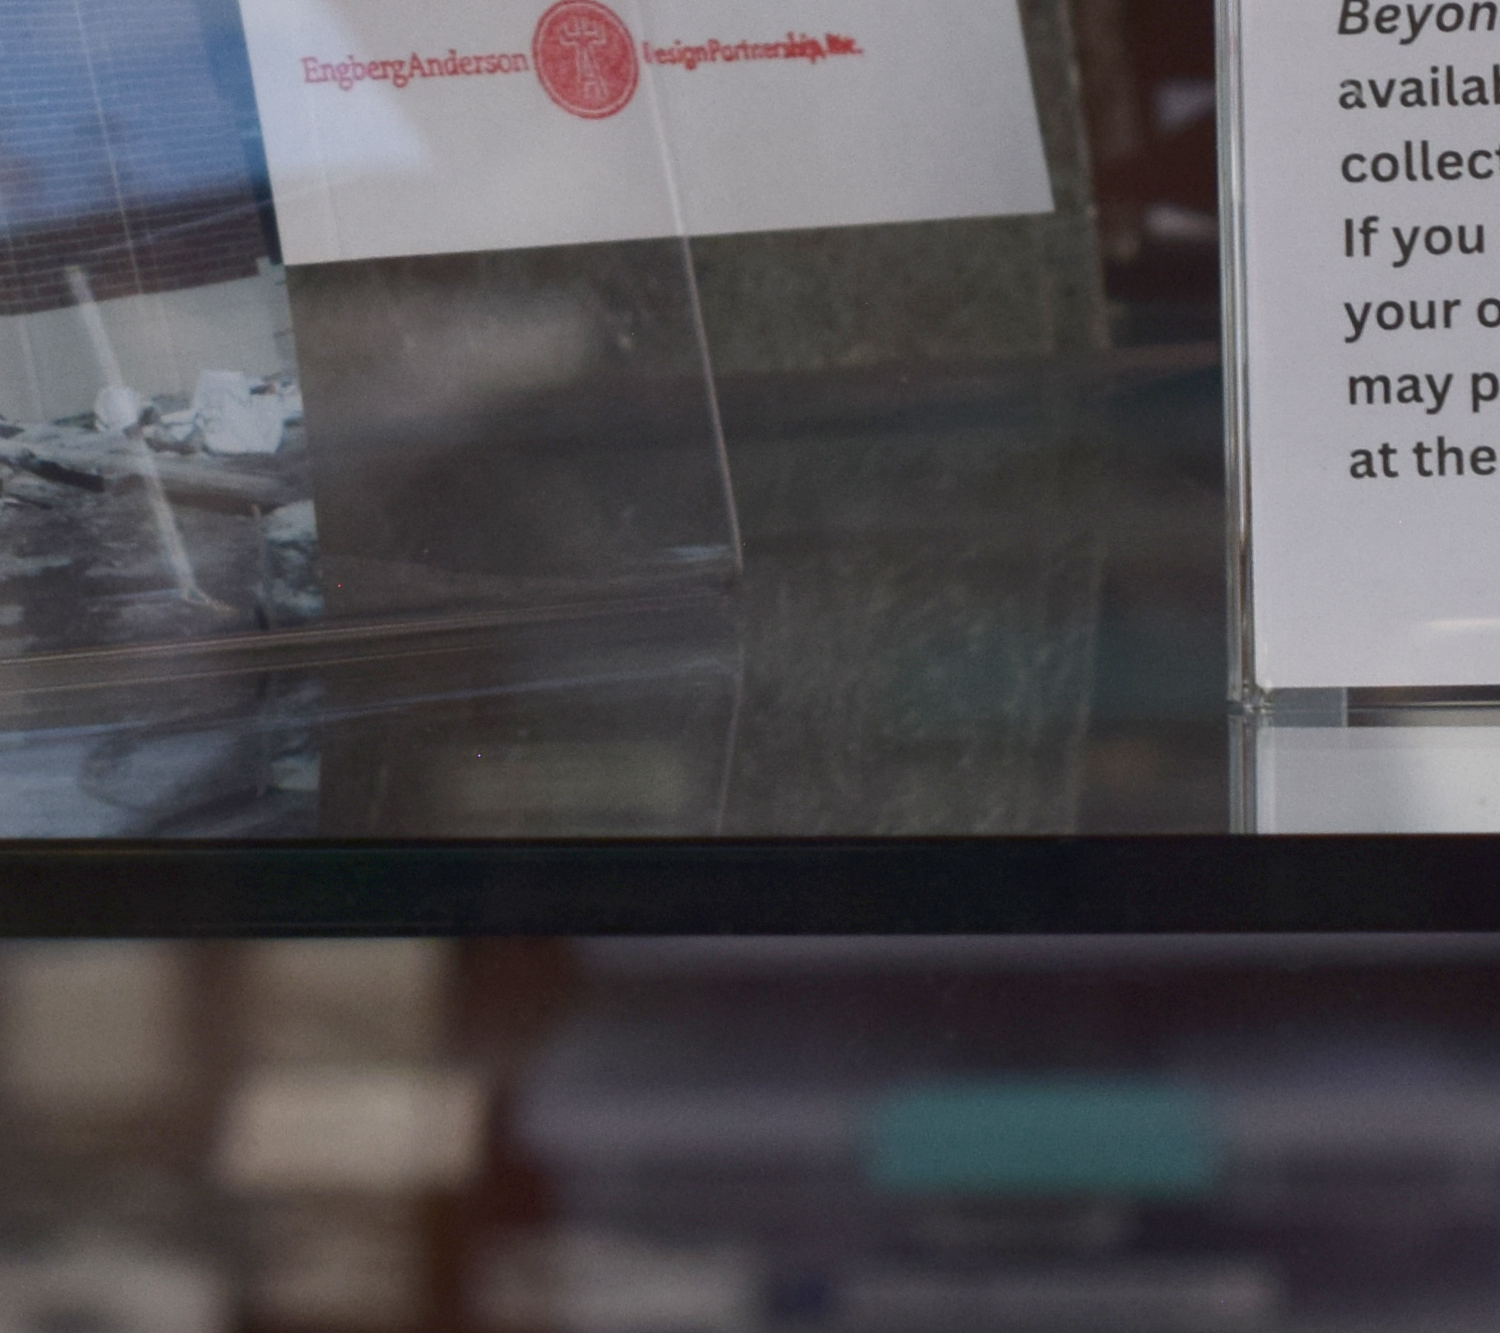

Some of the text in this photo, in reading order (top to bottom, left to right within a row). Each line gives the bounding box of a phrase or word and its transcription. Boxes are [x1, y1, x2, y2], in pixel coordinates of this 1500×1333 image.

[1343, 215, 1379, 258] If
[1391, 219, 1486, 269] you
[1343, 291, 1462, 344] your
[1347, 365, 1454, 415] may
[1347, 441, 1400, 481] at
[1411, 434, 1498, 479] the
